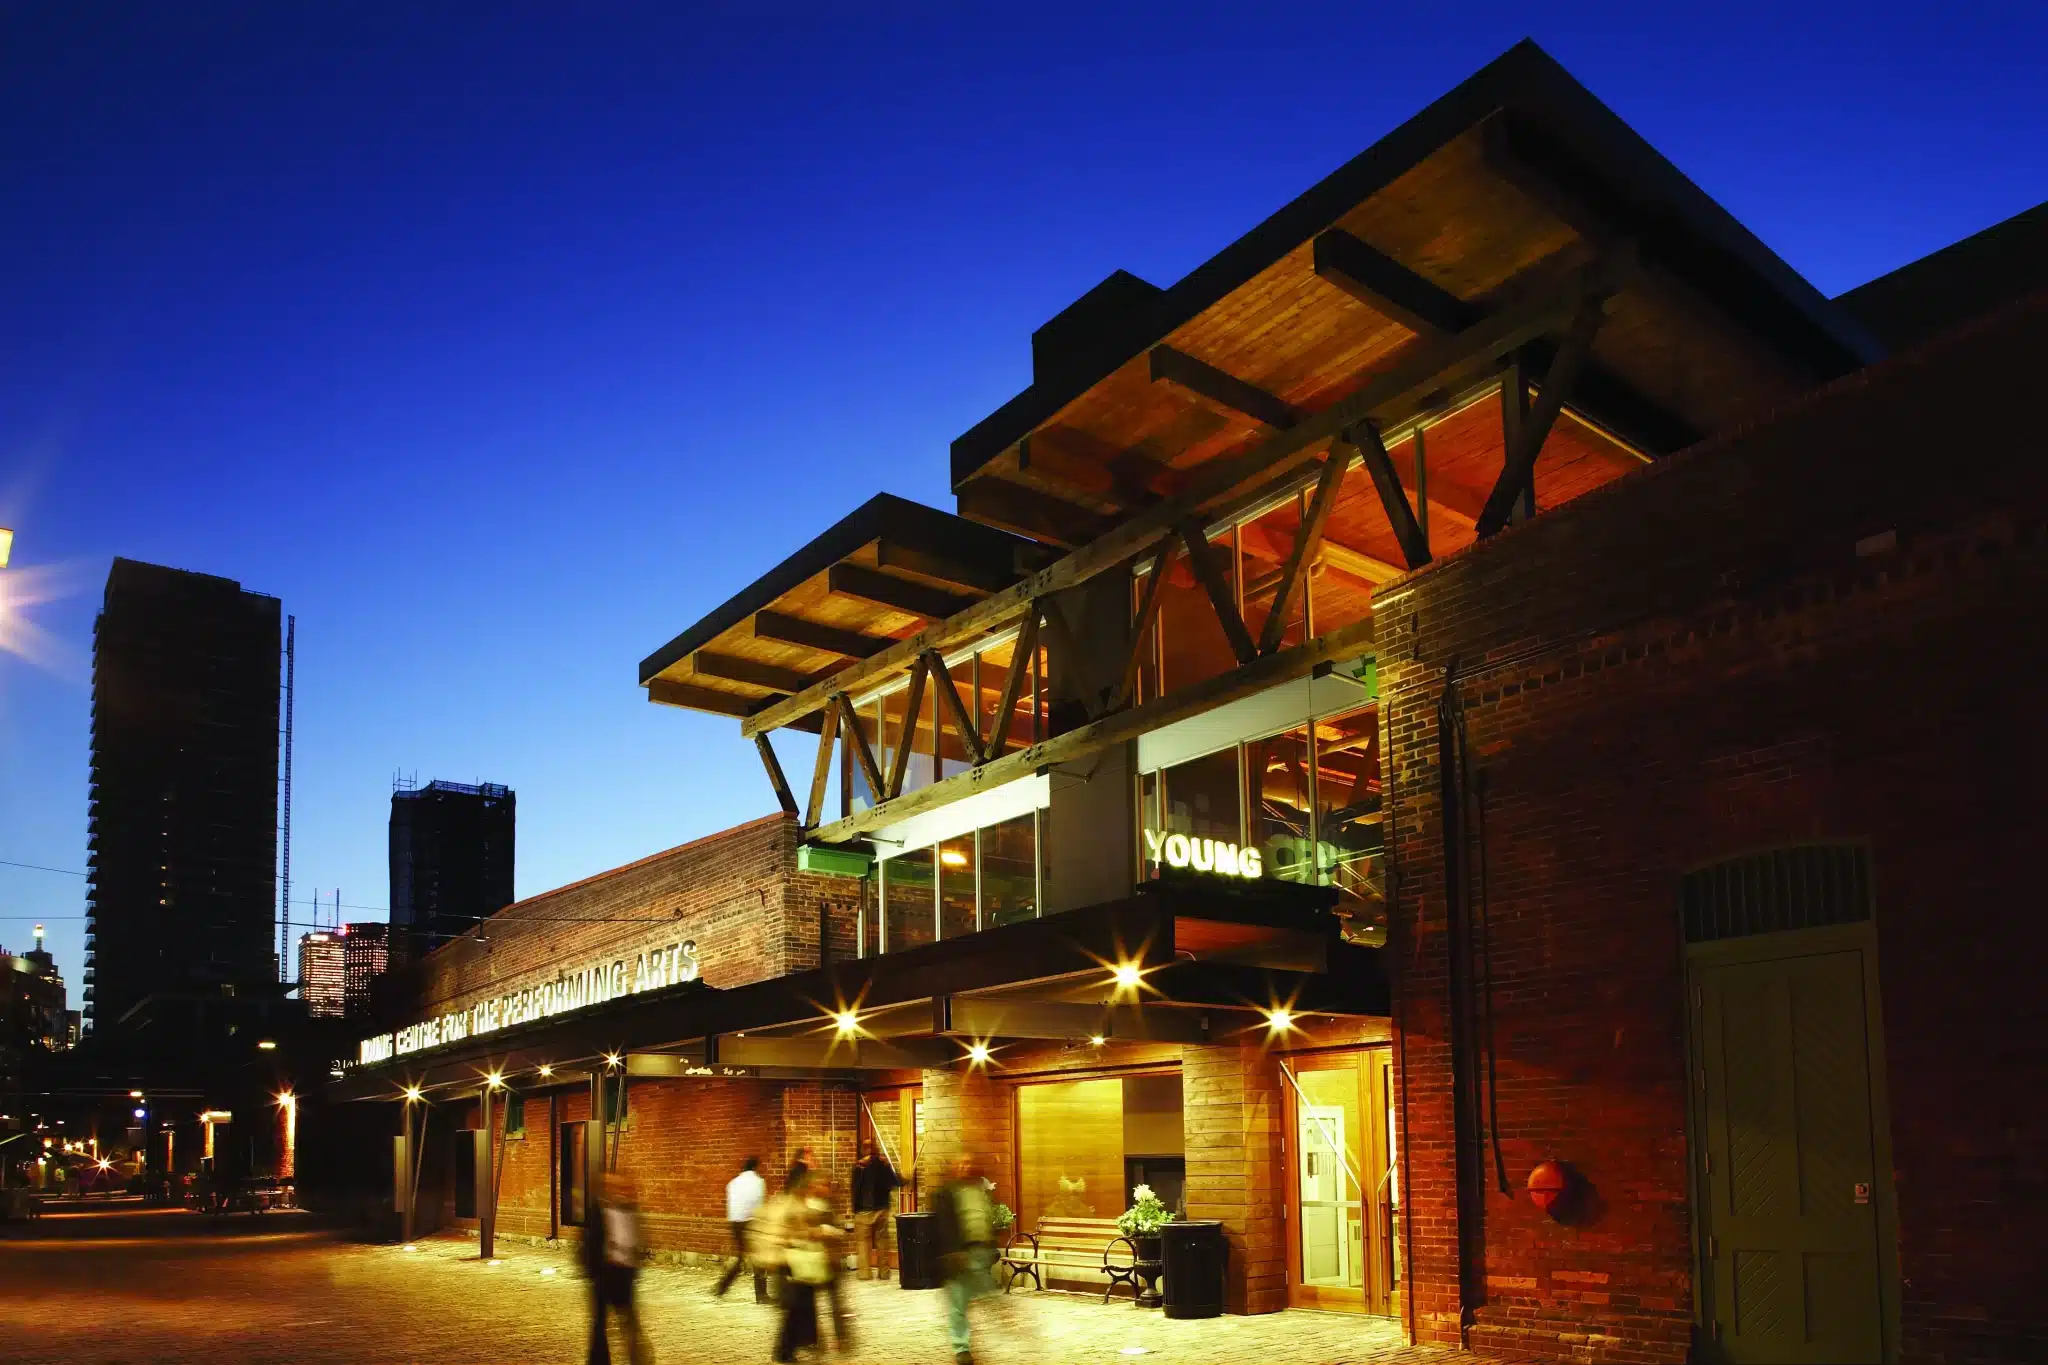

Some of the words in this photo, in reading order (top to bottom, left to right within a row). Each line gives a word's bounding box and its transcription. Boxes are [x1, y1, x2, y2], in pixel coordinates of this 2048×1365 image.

[1144, 828, 1263, 878] YOUNG
[396, 1017, 440, 1055] CENTRE
[441, 1010, 468, 1043] FOR
[470, 997, 499, 1035] THE
[502, 960, 628, 1028] PERFORMING
[632, 940, 698, 994] ARTS
